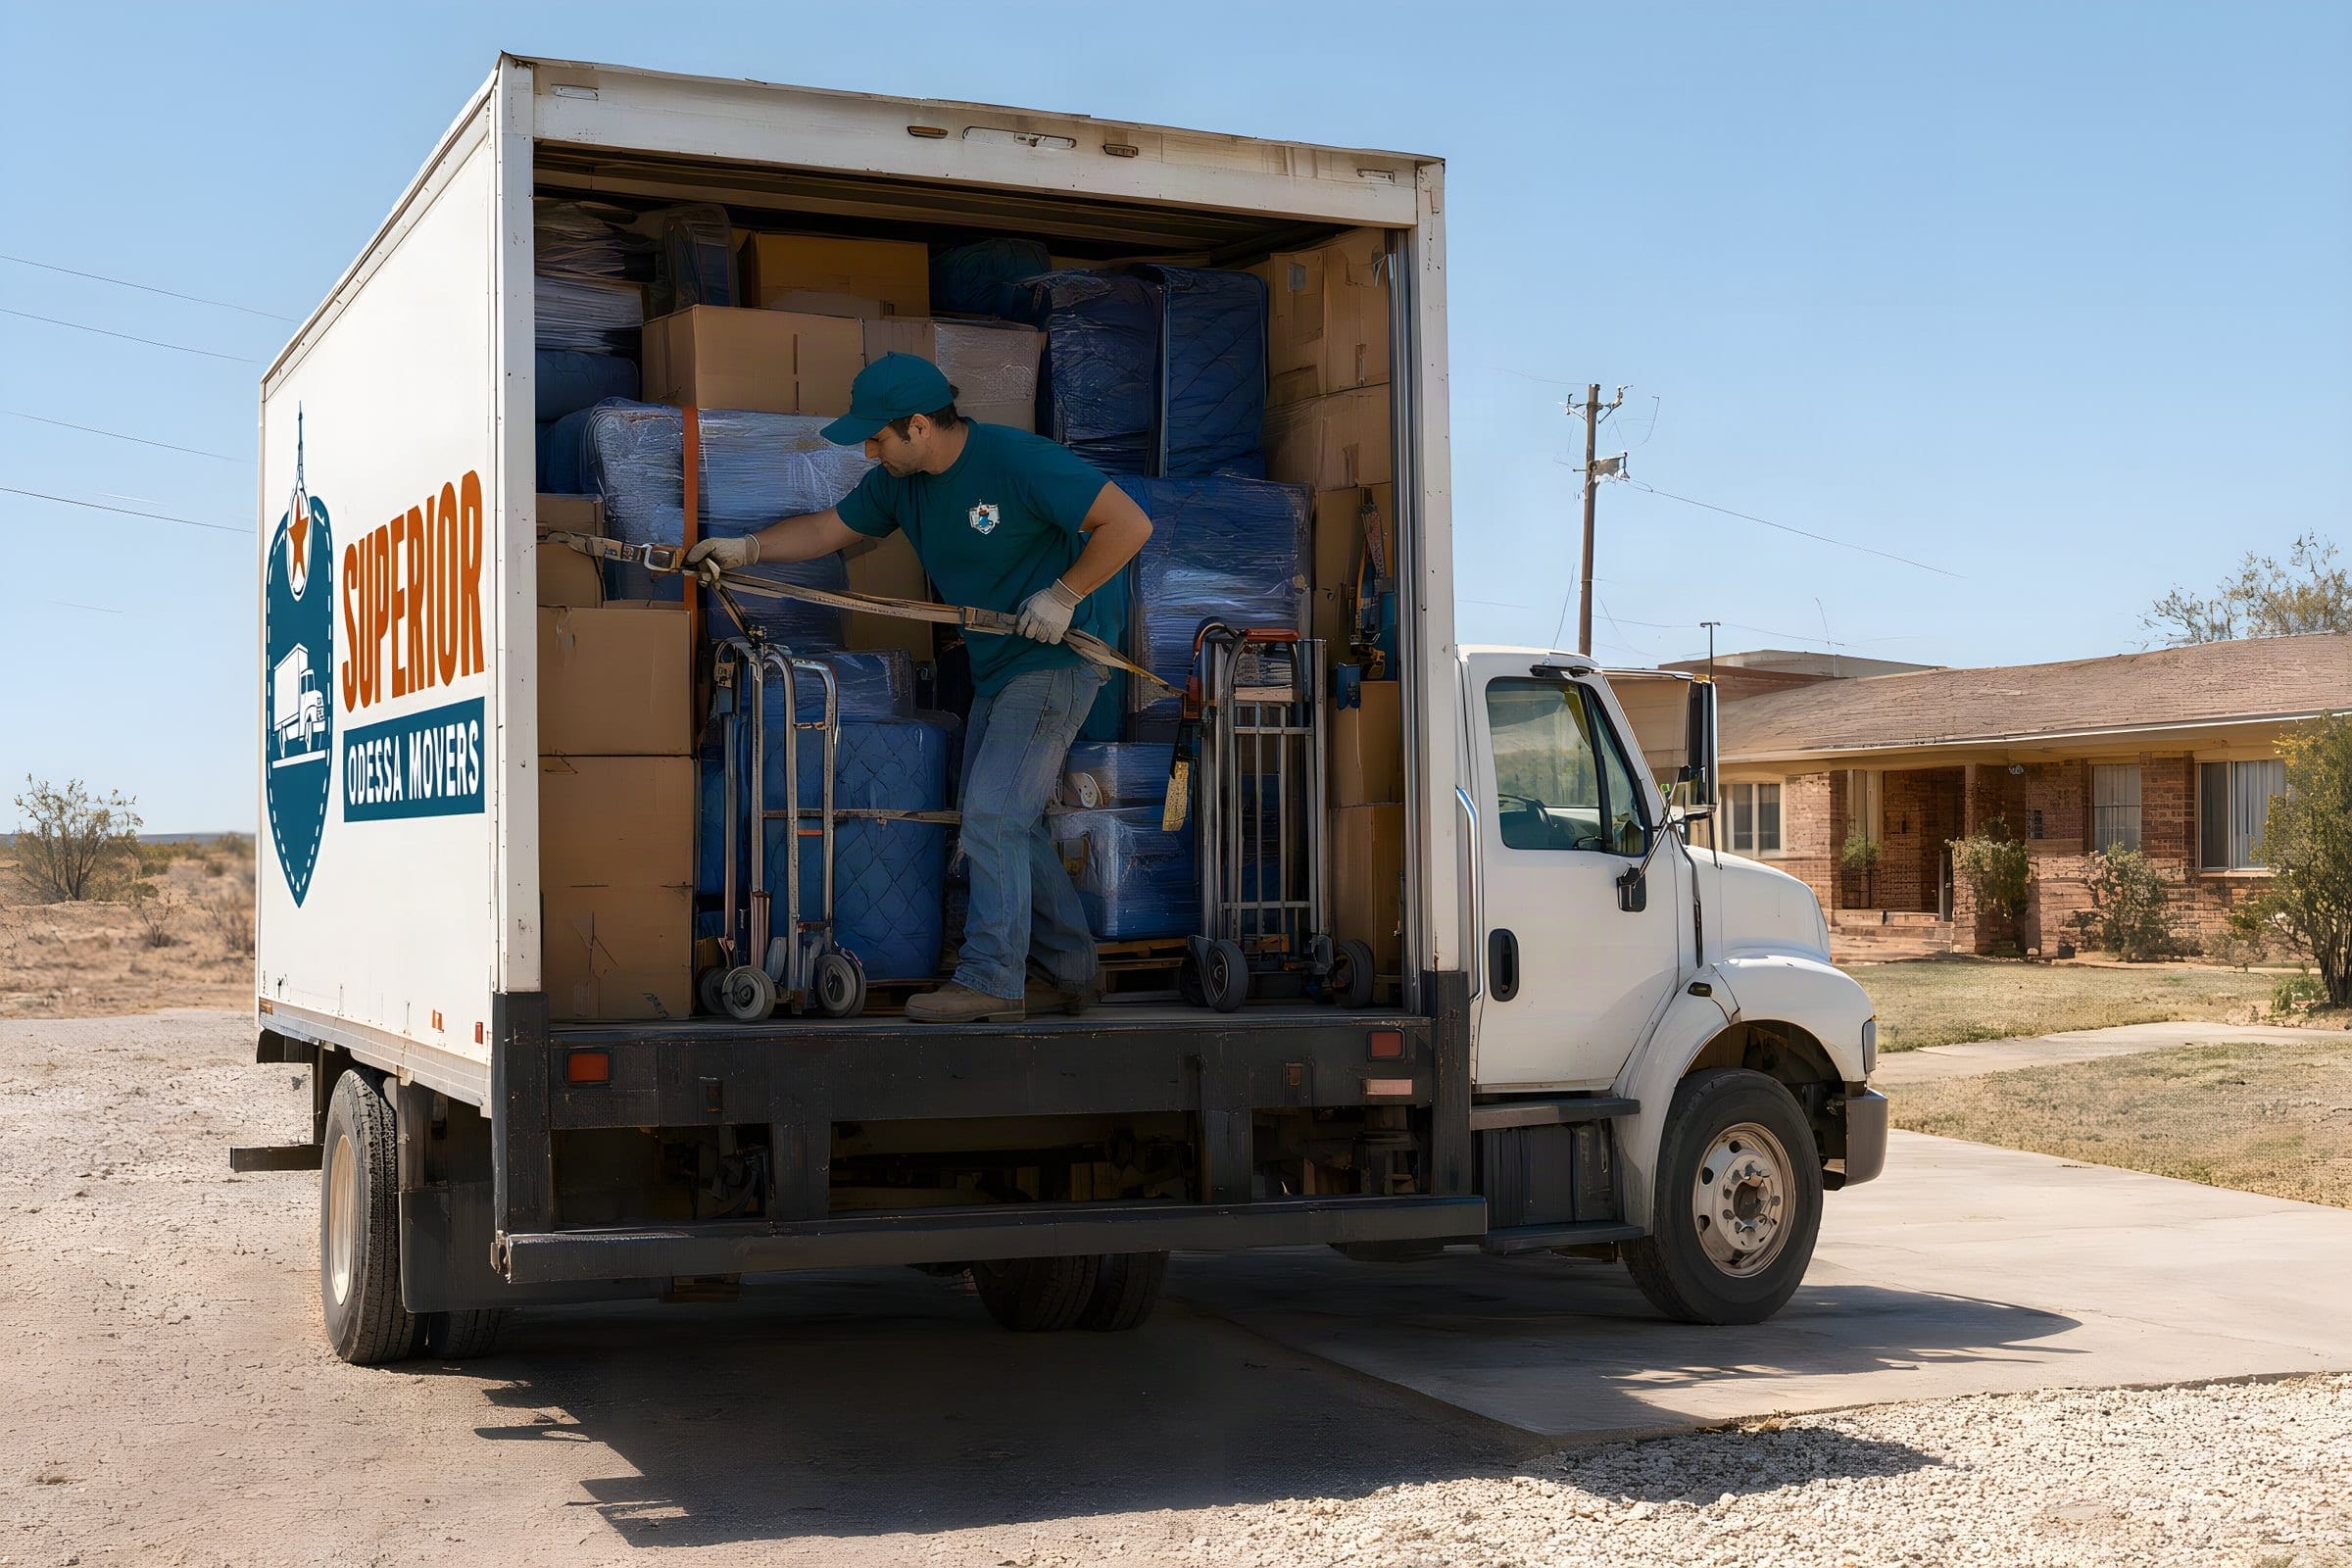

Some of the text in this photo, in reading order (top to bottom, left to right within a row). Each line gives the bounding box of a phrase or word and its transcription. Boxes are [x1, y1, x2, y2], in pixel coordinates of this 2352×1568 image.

[343, 469, 484, 713] SUPERIOR
[348, 718, 479, 806] ODESSA MOVERS
